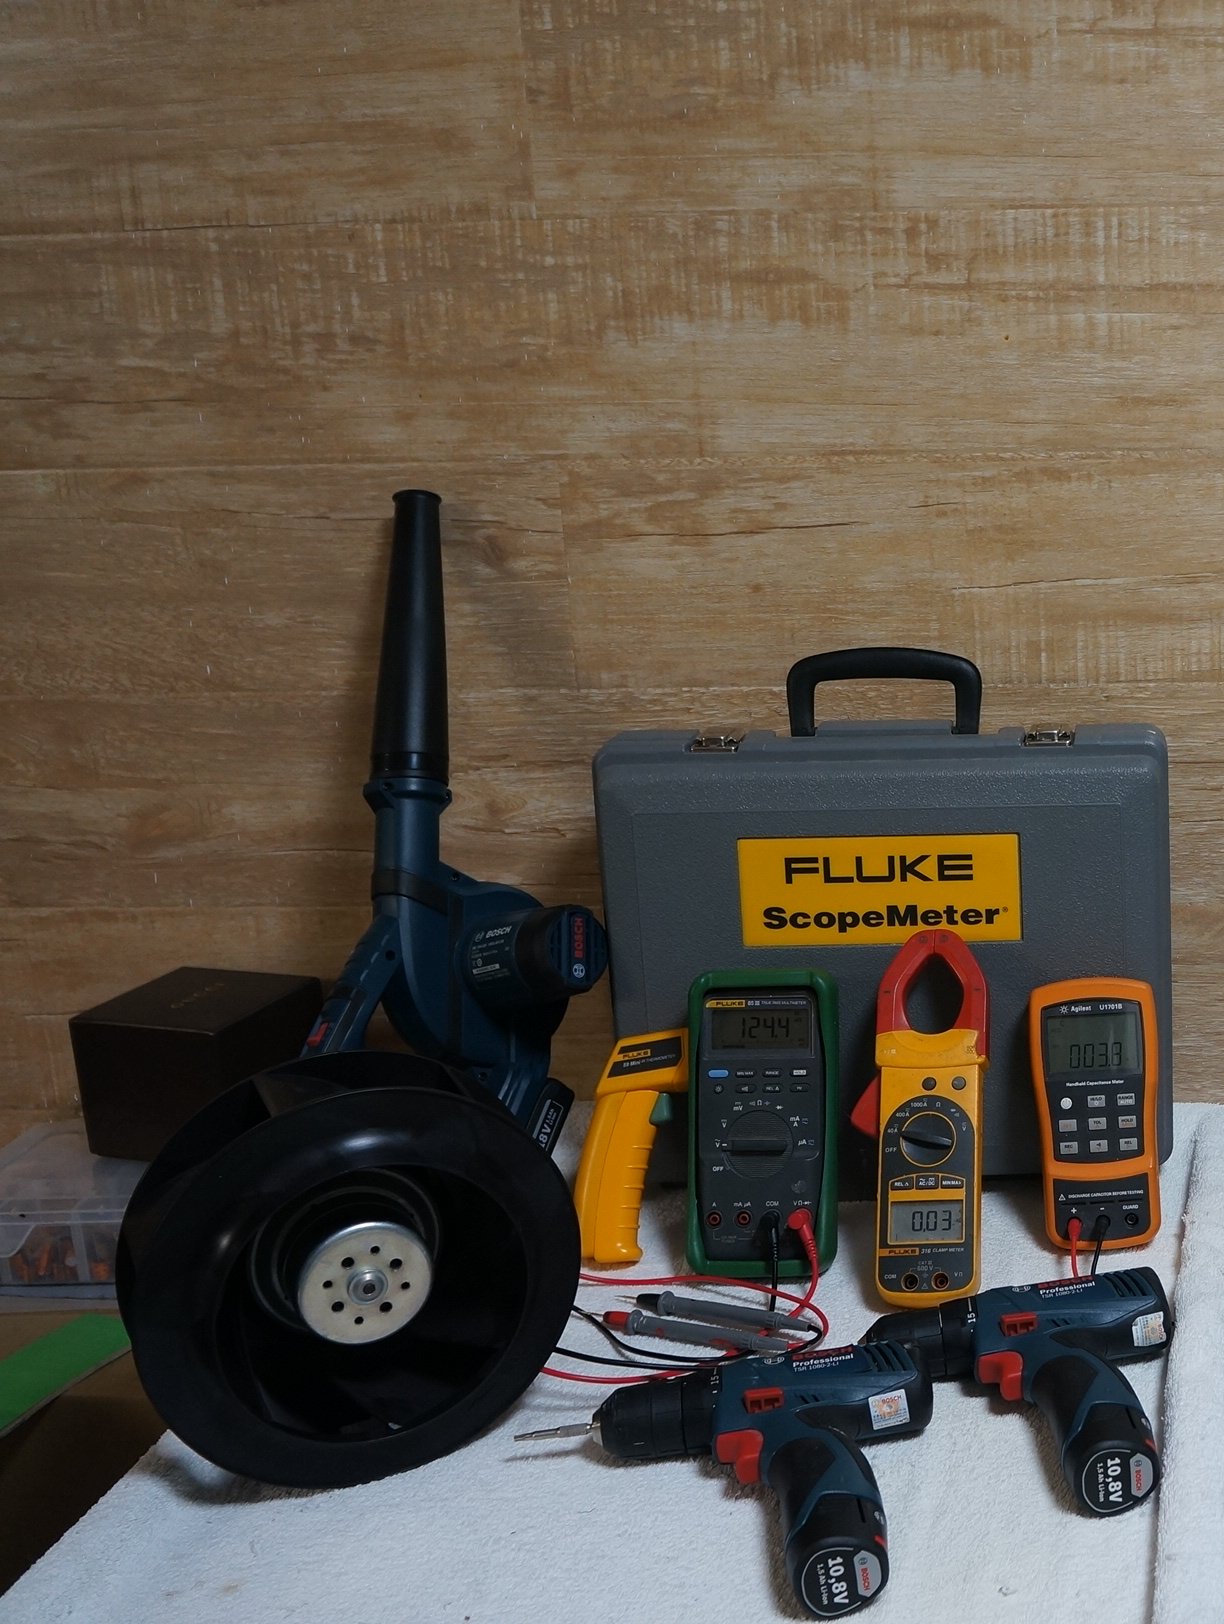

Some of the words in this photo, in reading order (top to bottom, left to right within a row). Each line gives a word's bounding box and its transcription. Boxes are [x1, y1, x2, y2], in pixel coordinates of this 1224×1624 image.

[784, 854, 974, 884] FLUKE
[486, 925, 512, 938] BOSCH
[742, 1016, 789, 1038] 124.4
[1040, 1281, 1096, 1295] Professional
[967, 1312, 976, 1323] 15
[792, 1353, 854, 1368] Professional
[710, 1375, 719, 1385] 15
[881, 1394, 902, 1403] BOSCH
[1106, 1457, 1123, 1502] 10,8V
[828, 1556, 849, 1603] 10,8V
[861, 1567, 870, 1591] BOSCH
